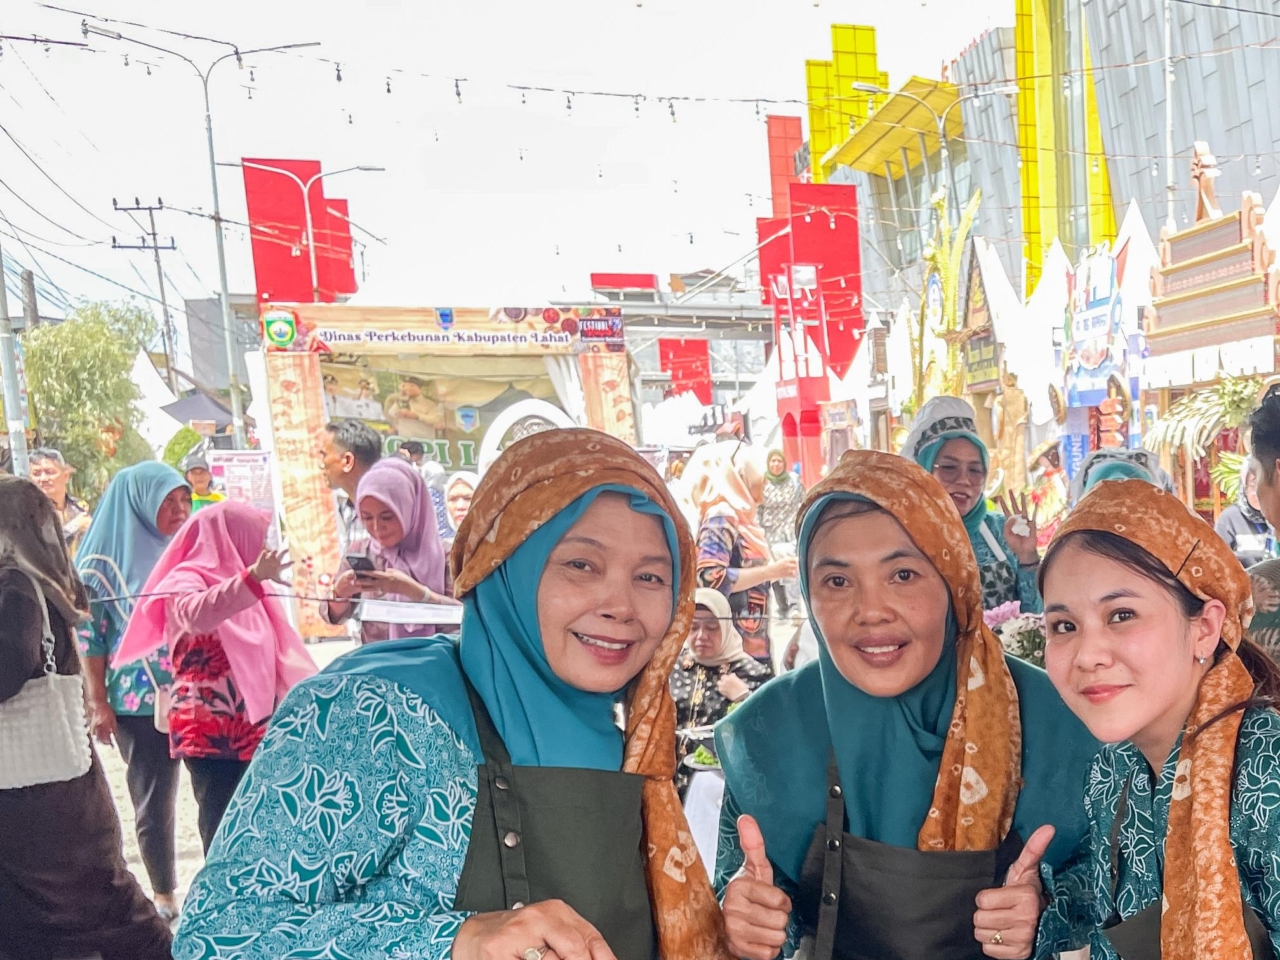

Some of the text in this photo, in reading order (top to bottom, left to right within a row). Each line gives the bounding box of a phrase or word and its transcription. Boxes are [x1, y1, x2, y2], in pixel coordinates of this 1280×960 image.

[320, 331, 361, 342] Dinas
[365, 331, 450, 342] Perkebunan
[453, 331, 527, 344] Kabupaten
[530, 332, 570, 343] Lahat
